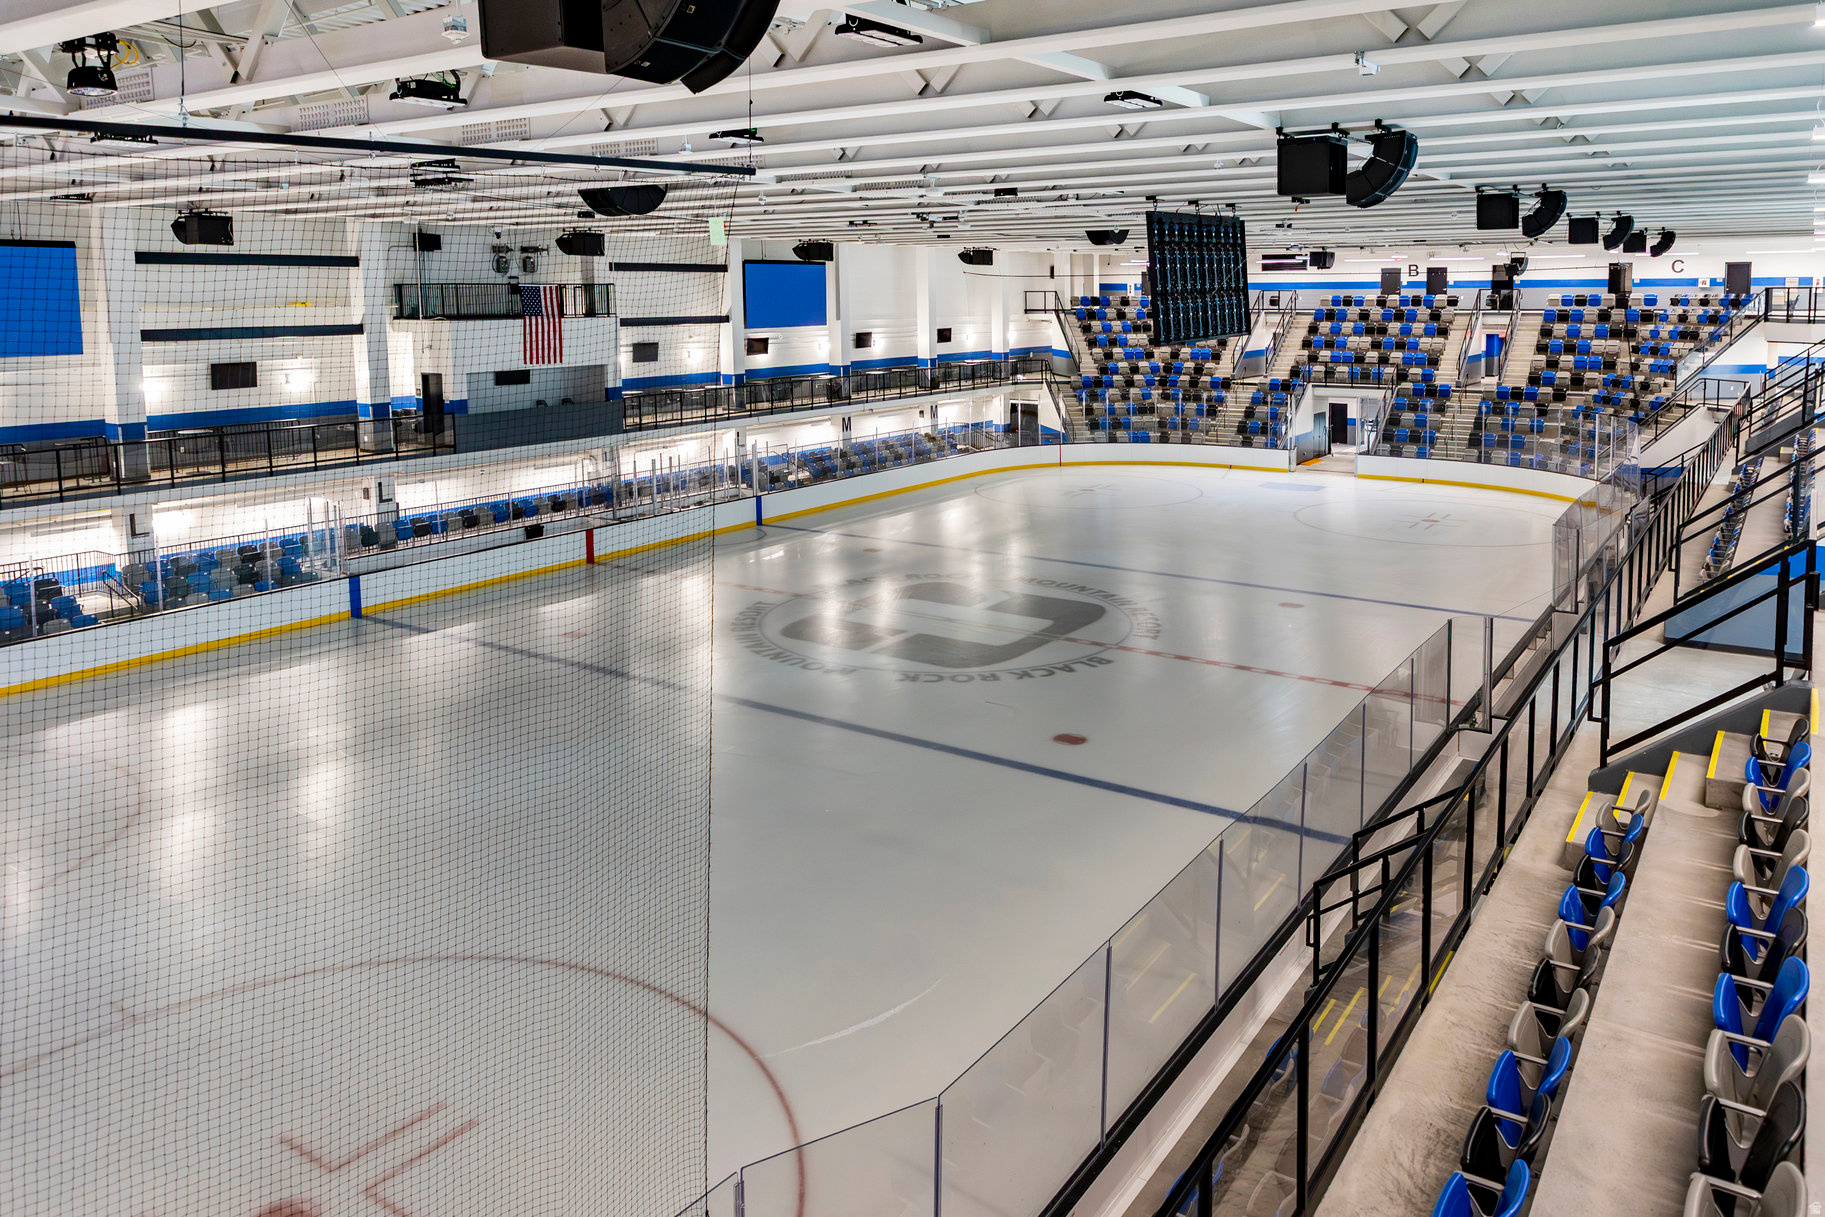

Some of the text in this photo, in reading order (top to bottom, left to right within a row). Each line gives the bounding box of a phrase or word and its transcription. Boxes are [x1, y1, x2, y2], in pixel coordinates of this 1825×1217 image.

[1408, 264, 1419, 277] B
[1671, 259, 1685, 273] C
[930, 404, 938, 419] M
[842, 416, 852, 432] M
[378, 481, 393, 503] L
[129, 513, 150, 537] L
[896, 656, 1114, 684] BLACK ROCK
